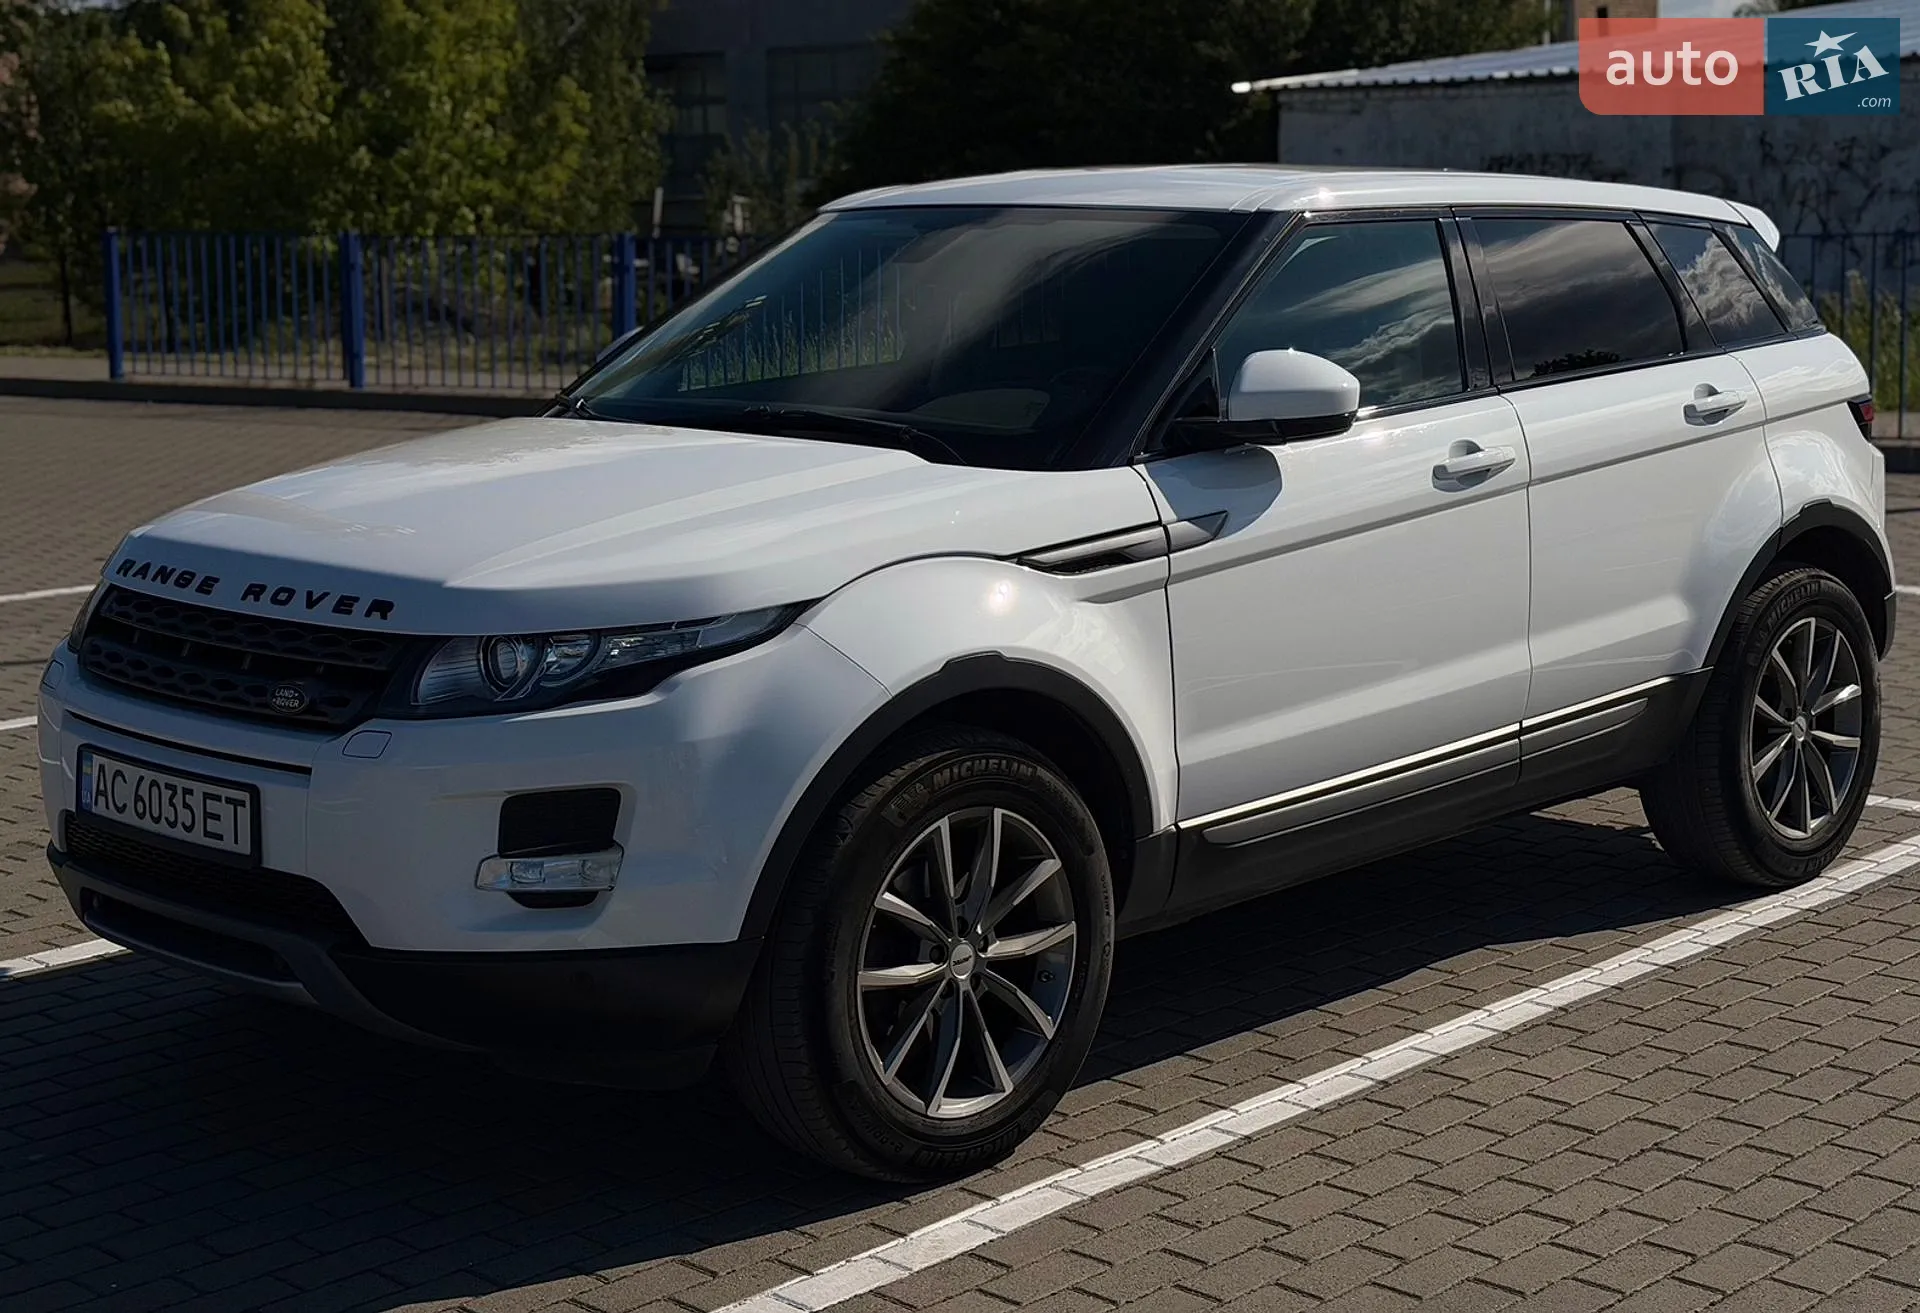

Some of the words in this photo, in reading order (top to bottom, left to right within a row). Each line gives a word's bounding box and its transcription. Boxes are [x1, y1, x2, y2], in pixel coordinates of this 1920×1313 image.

[115, 558, 220, 596] RANGE
[240, 583, 396, 621] ROVER
[275, 688, 295, 698] LAND
[276, 697, 300, 709] ROVER
[932, 758, 1037, 790] MICHELIN
